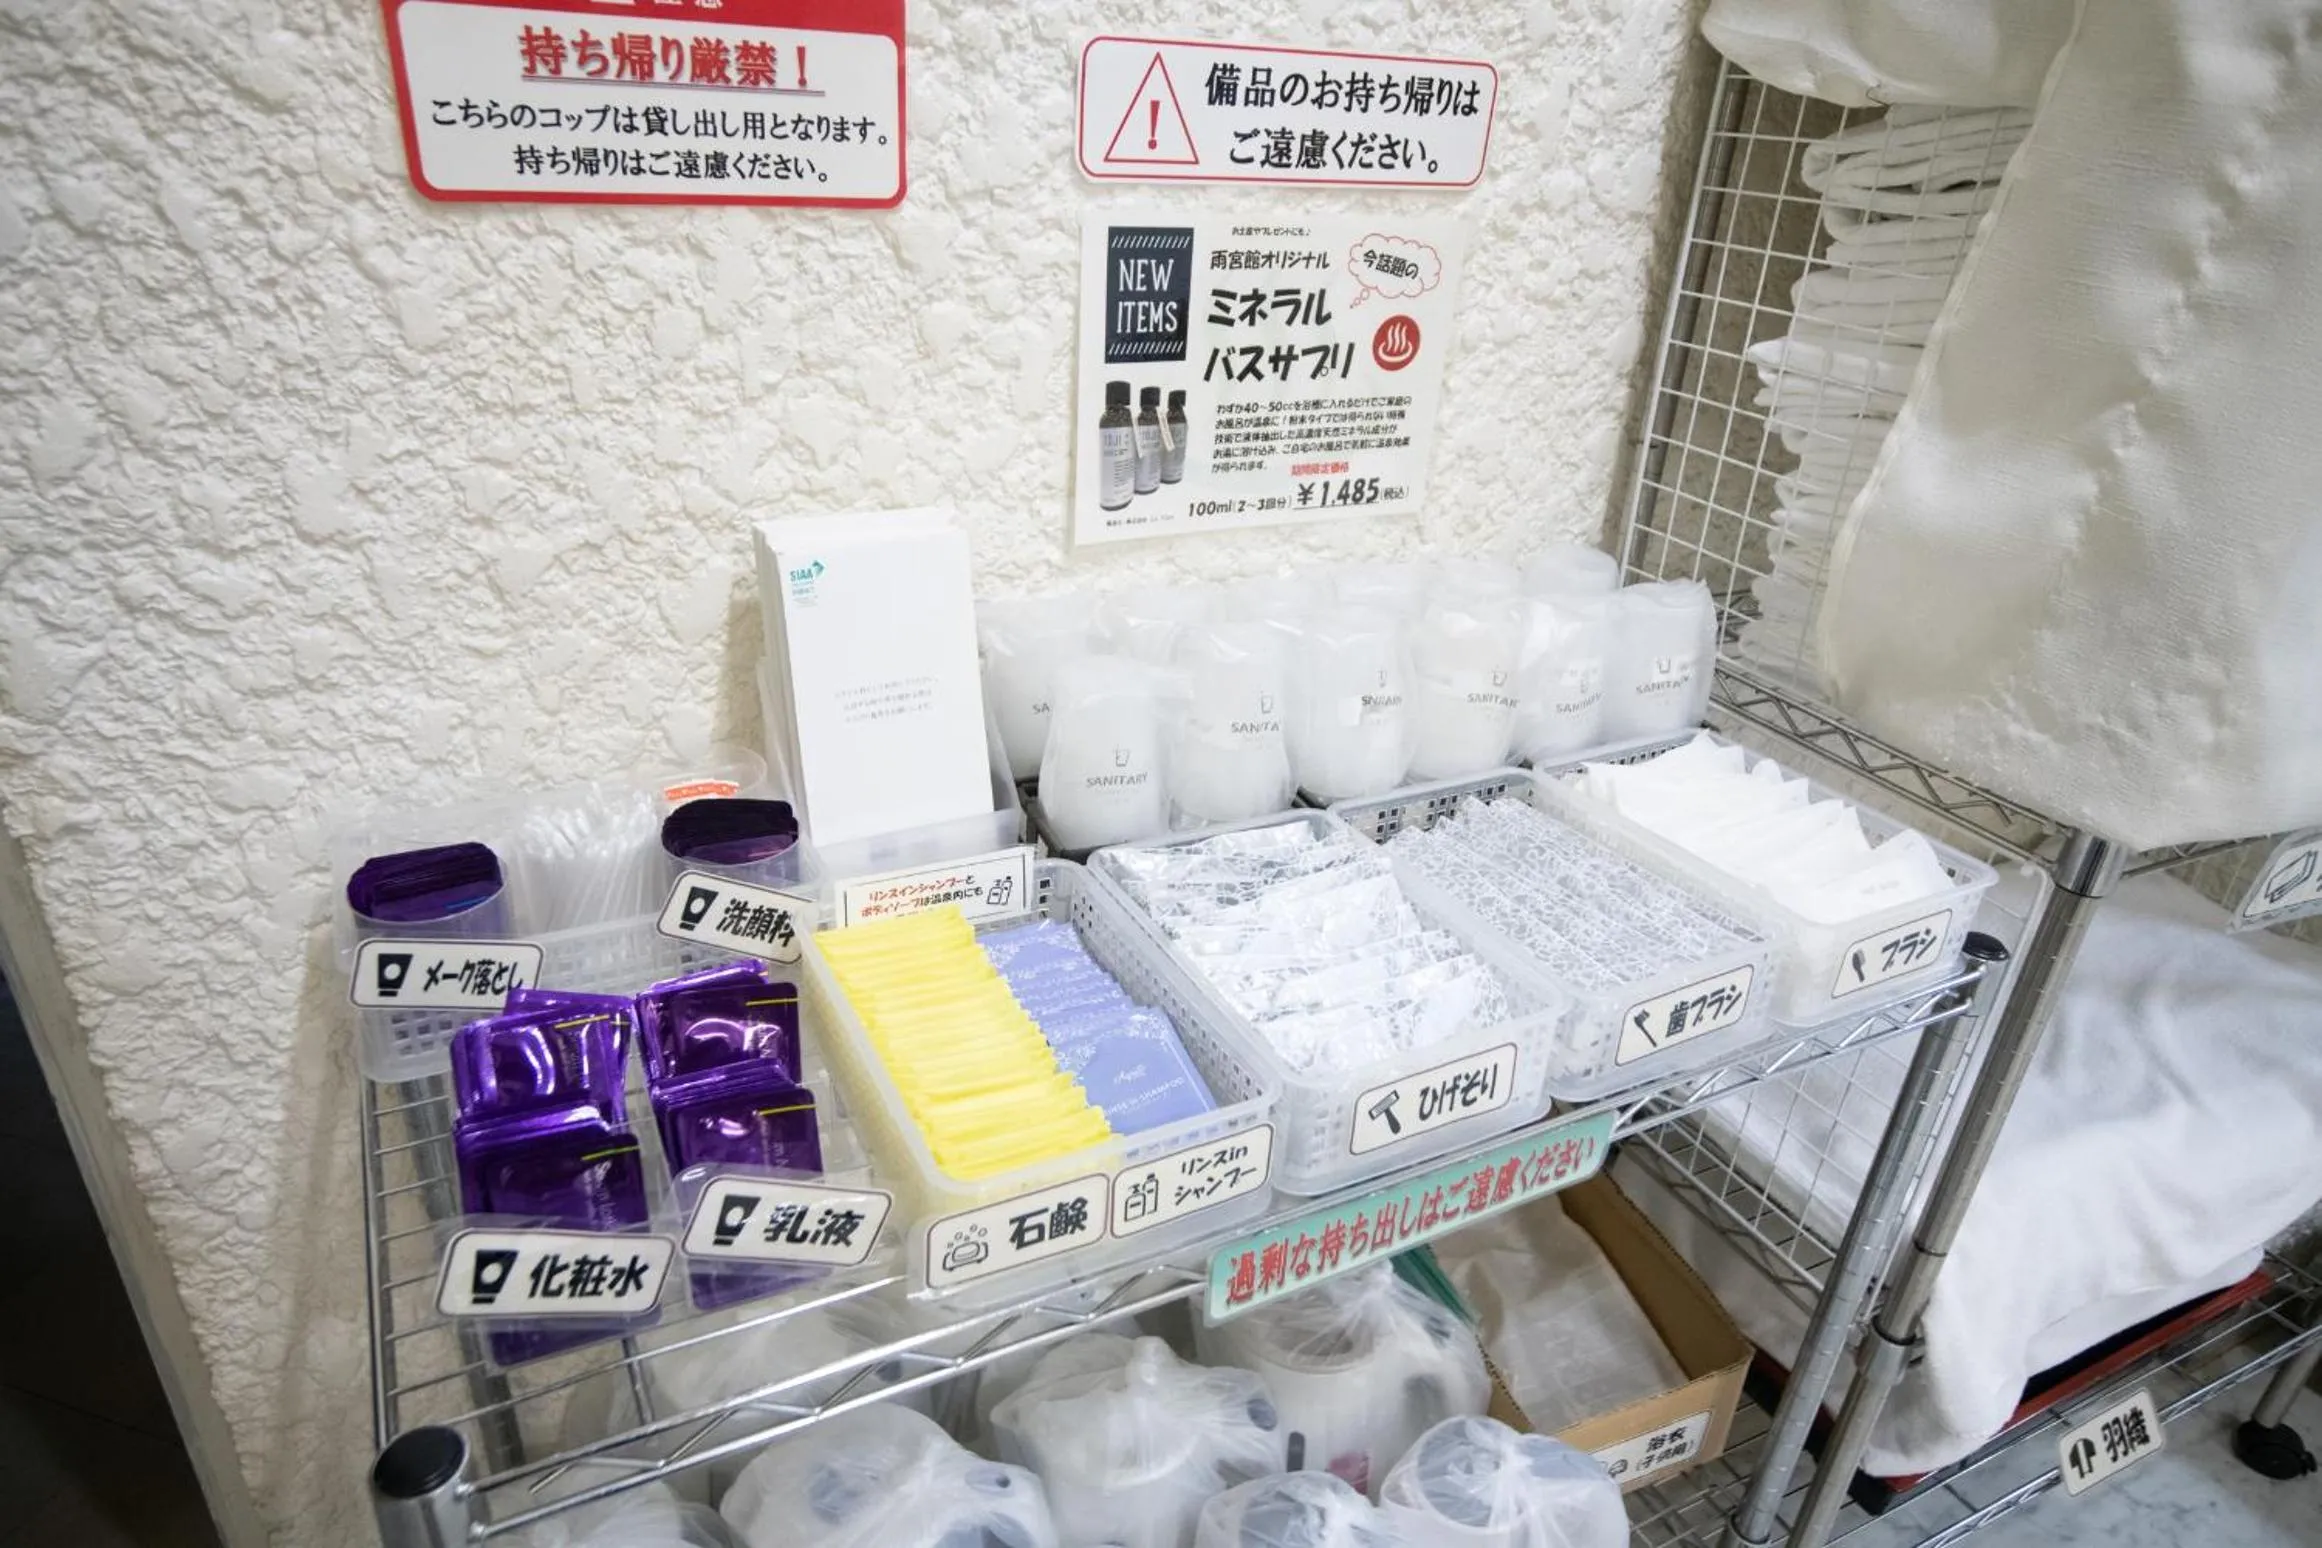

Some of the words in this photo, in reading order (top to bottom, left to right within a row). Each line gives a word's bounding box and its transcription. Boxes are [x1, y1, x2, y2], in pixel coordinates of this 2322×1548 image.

[519, 25, 809, 88] 持ち帰り厳禁！
[1205, 61, 1480, 117] 備品のお持ち帰りは
[431, 98, 888, 145] こちらのコップは貸し出し用となります。
[514, 145, 828, 183] 持ち帰りはご遠慮ください。
[1229, 126, 1438, 173] ご遠慮ください。
[1118, 258, 1175, 292] NEW
[1209, 249, 1331, 270] 雨宮館オリジナル
[1363, 249, 1419, 280] 今話題の
[1115, 300, 1178, 334] ITEMS
[1206, 288, 1333, 328] ミネラル
[1203, 341, 1355, 383] バスサプリ
[1231, 720, 1280, 734] SANITA
[1086, 771, 1149, 788] SANITARY
[1881, 927, 1938, 973] ブラシ
[423, 958, 525, 995] メーク落とし
[1665, 984, 1743, 1038] 歯ブラシ
[1418, 1062, 1499, 1121] ひげそり
[1181, 1146, 1248, 1175] リンスin
[762, 1202, 865, 1248] 乳液
[1009, 1196, 1088, 1250] 石鹸
[1225, 1136, 1595, 1304] 過剰な持ち出しはご遠慮ください
[528, 1254, 650, 1299] 化粧水
[2101, 1406, 2151, 1463] 羽織
